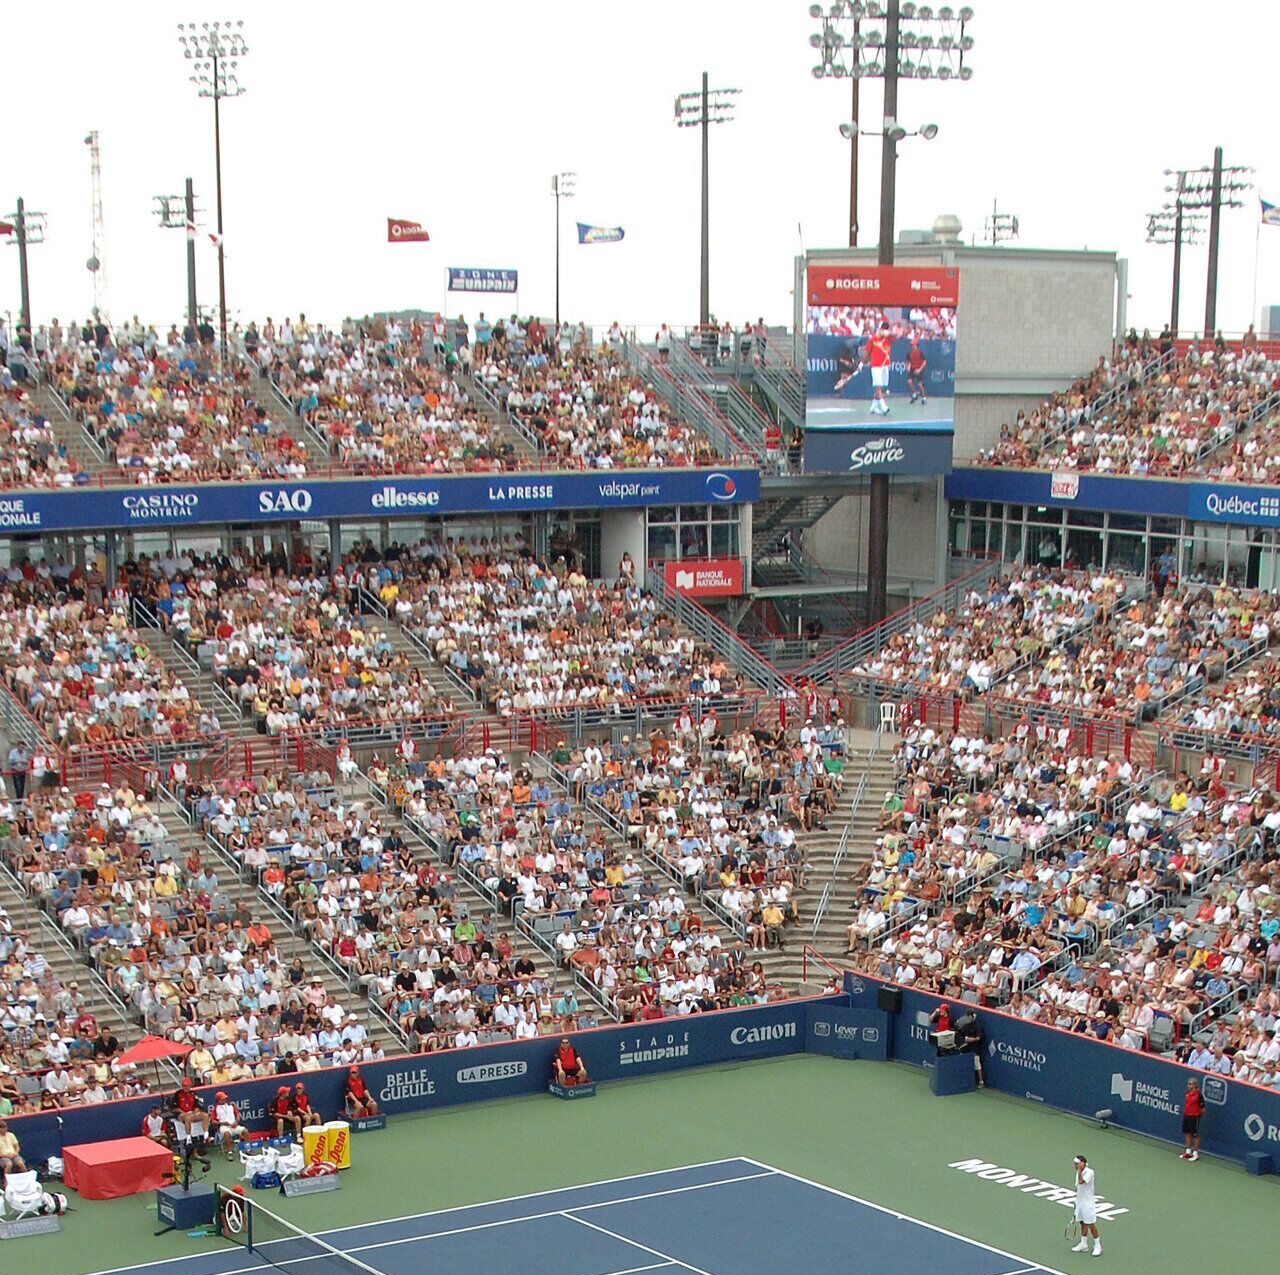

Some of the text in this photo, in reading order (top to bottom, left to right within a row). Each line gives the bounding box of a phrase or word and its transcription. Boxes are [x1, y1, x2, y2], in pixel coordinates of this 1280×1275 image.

[459, 269, 509, 279] ZONE
[836, 279, 881, 289] ROGERS
[849, 446, 905, 471] Source
[371, 487, 439, 508] ellesse
[489, 486, 553, 500] LA PRESSE
[598, 480, 640, 500] valspar
[123, 494, 198, 508] CASINO
[259, 490, 312, 513] SAQ
[1206, 493, 1258, 516] Québec
[130, 506, 192, 518] MONTRÉAL
[730, 1022, 796, 1044] Canon
[834, 1023, 858, 1036] Lever
[910, 1025, 929, 1042] IRI
[620, 1032, 690, 1051] STADE
[997, 1042, 1046, 1064] CASINO
[461, 1063, 523, 1081] LA PRESSE
[1002, 1054, 1042, 1072] MONTRÉAL
[386, 1069, 428, 1088] BELLE
[380, 1081, 436, 1102] GUEULE
[1136, 1081, 1170, 1100] BANQUE
[1134, 1092, 1180, 1115] NATIONALE
[310, 1134, 326, 1166] Penn
[330, 1130, 346, 1164] Penn
